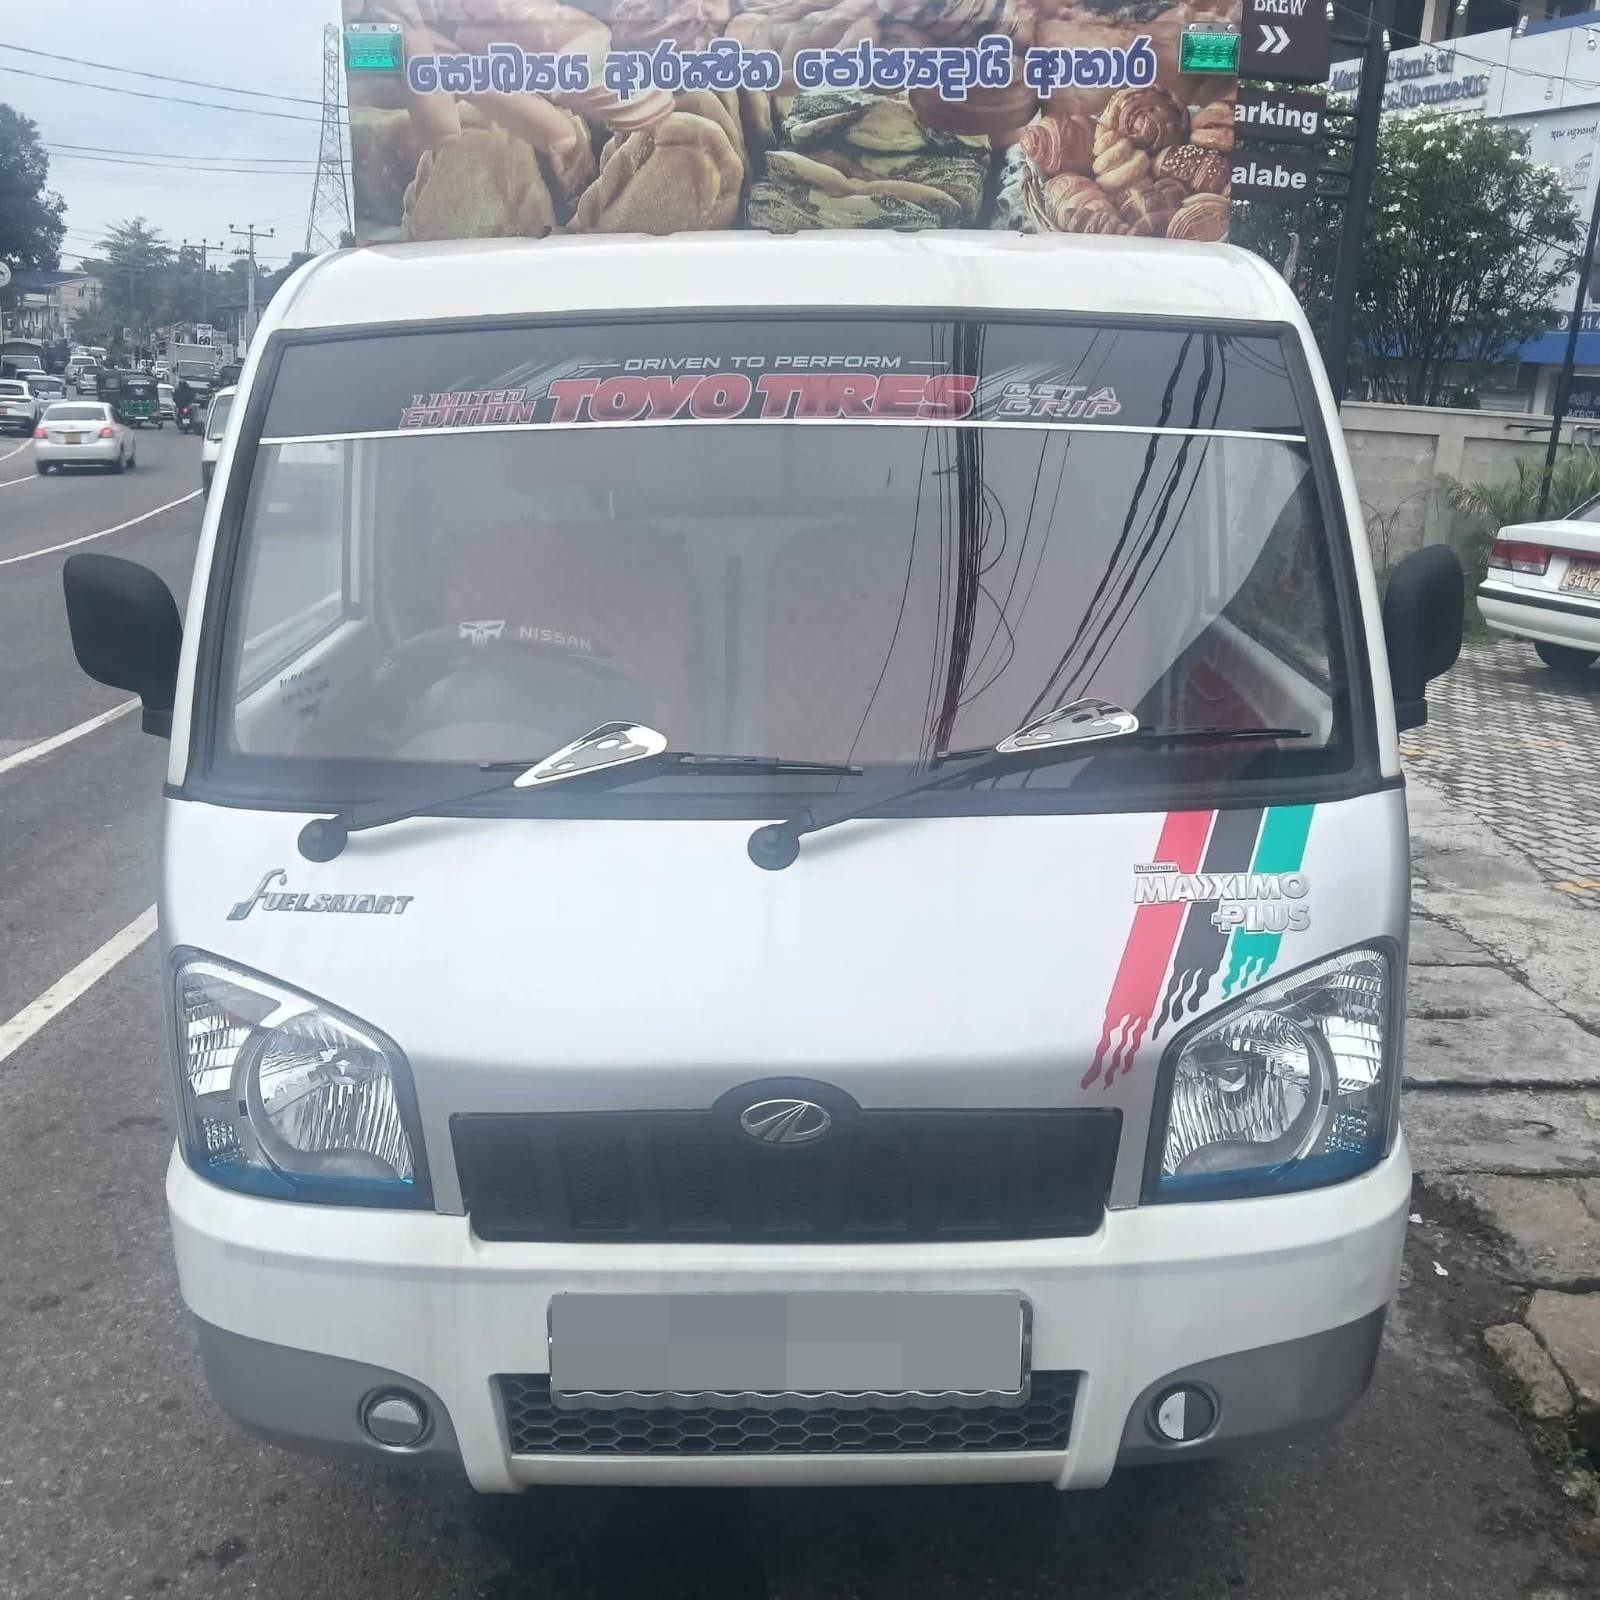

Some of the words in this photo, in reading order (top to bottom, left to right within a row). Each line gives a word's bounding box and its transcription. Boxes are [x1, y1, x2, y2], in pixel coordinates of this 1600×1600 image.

[1023, 34, 1157, 98] ආහාර
[624, 356, 721, 371] DRIVEN
[730, 356, 765, 369] TO
[775, 355, 902, 369] PERFORM
[411, 388, 527, 408] LIMITED
[545, 373, 752, 422] TOYO
[756, 373, 979, 420] TIRES
[1002, 382, 1086, 399] GET
[1087, 385, 1118, 400] A
[396, 403, 537, 430] EDITION
[995, 398, 1122, 419] GRIP
[519, 625, 592, 651] NISSAN
